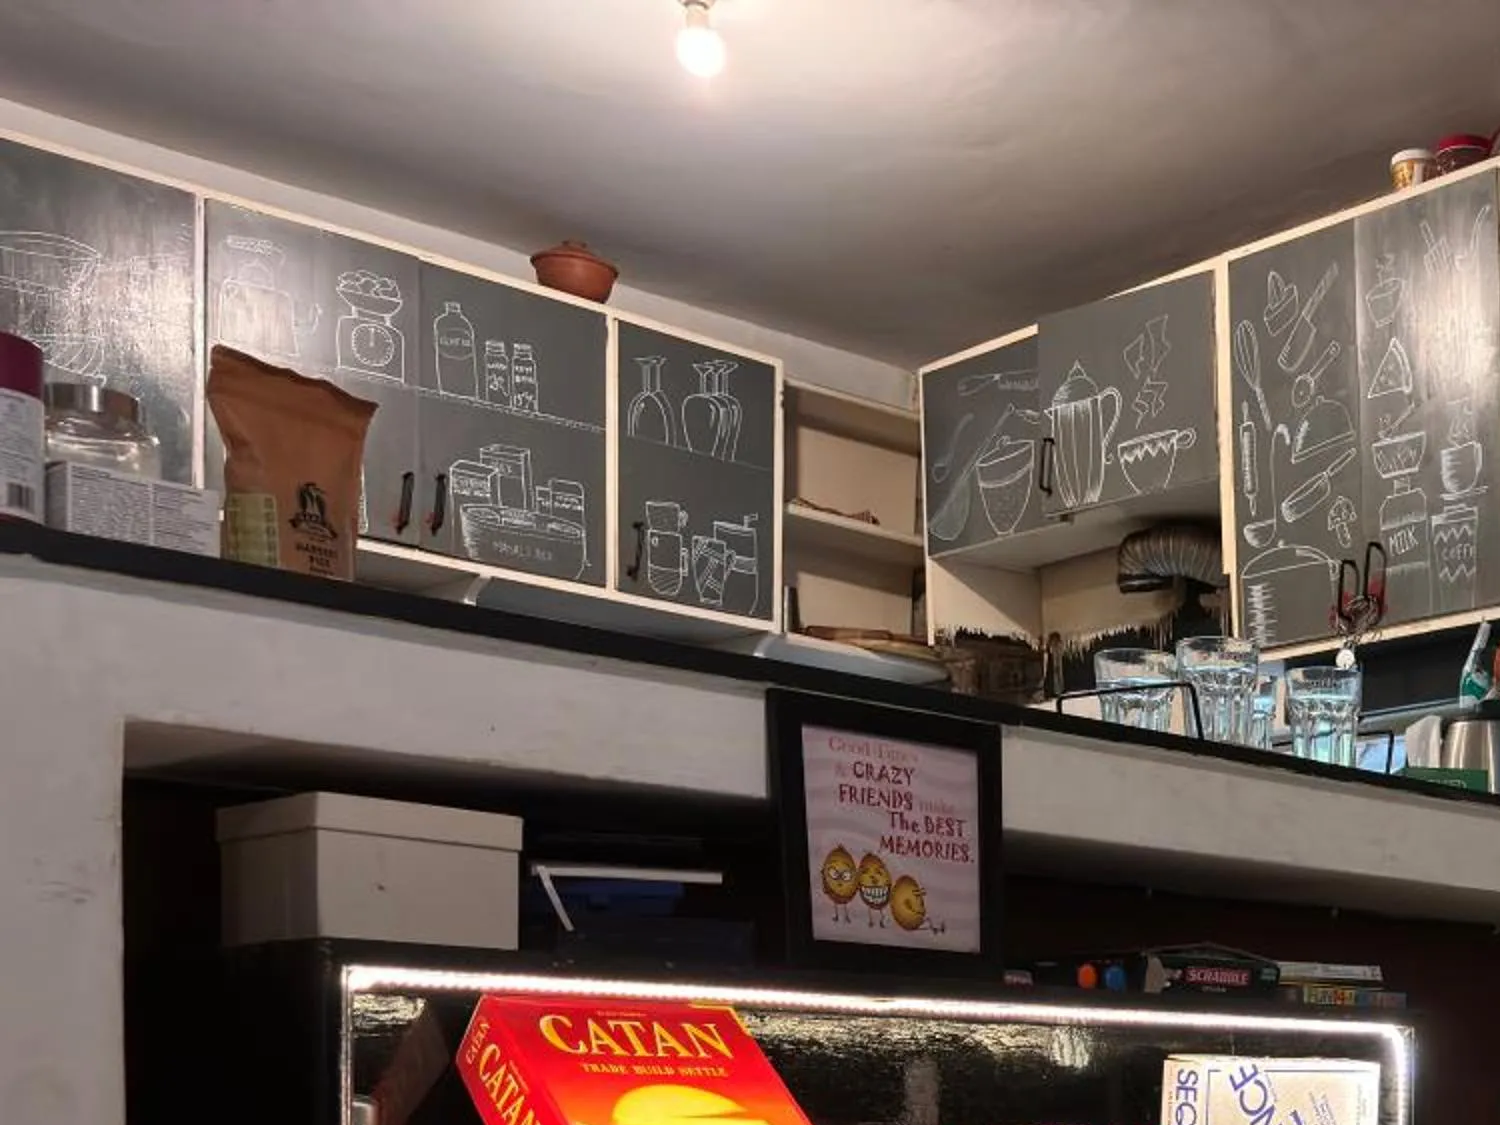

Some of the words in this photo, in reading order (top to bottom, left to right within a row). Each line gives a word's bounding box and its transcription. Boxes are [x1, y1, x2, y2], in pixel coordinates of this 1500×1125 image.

[852, 761, 916, 787] CRAZY
[838, 783, 913, 811] FRIENDS
[889, 811, 921, 834] The
[923, 815, 968, 838] BEST
[539, 1014, 734, 1059] CATAN
